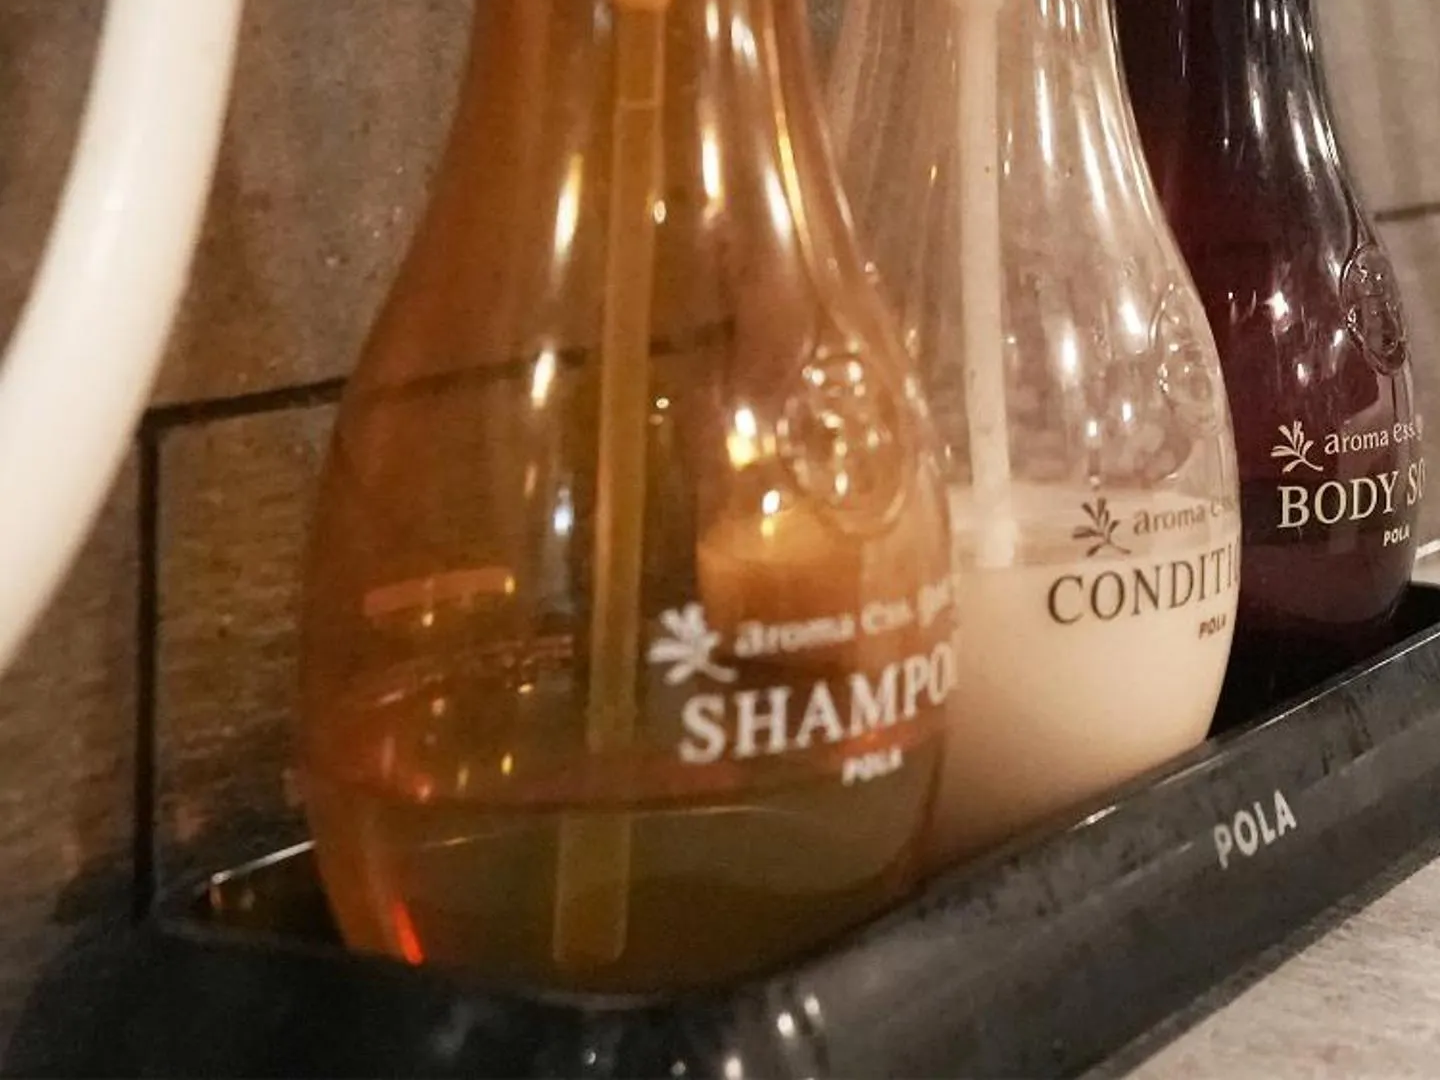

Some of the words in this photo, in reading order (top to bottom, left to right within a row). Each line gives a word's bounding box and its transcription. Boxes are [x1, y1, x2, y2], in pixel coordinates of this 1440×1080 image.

[1324, 429, 1389, 455] aroma
[1277, 471, 1399, 528] BODY
[1133, 504, 1206, 535] aroma
[1383, 523, 1411, 547] POLA
[734, 612, 857, 657] aroma
[1213, 789, 1297, 870] POLA
